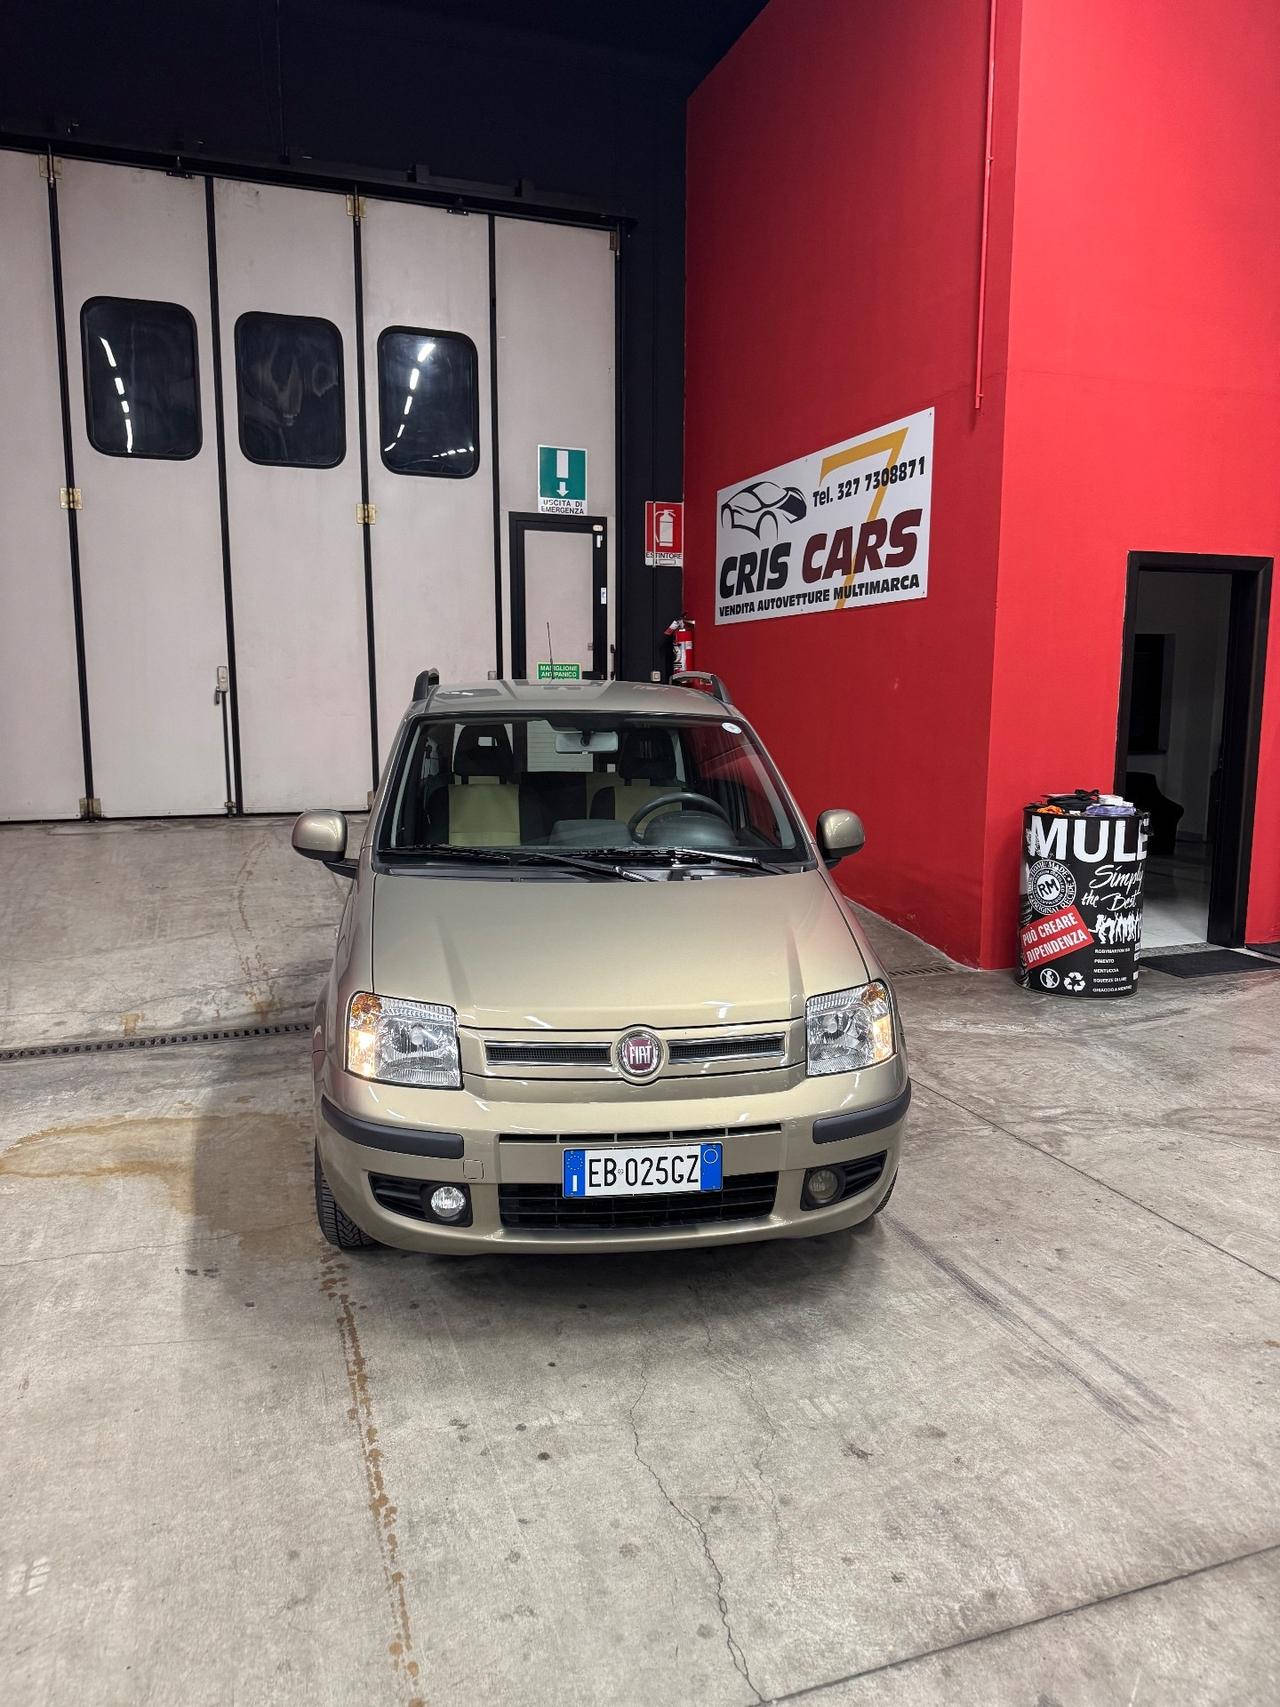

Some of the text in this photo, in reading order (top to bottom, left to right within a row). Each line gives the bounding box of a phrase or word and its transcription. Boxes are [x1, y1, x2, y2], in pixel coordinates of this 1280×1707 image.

[813, 456, 925, 507] Tel. 327 7308871
[541, 506, 584, 514] EMERGENZA
[543, 499, 571, 507] USCITA
[719, 508, 923, 599] CRIS CARS
[719, 574, 920, 617] VENDITA AUTOVETTURE MULTIMARCA
[1038, 878, 1060, 898] RM
[1081, 889, 1141, 911] the Best
[1022, 912, 1078, 946] PUÒ CREARE
[1026, 929, 1088, 963] DIPENDENZA
[629, 1045, 652, 1065] FIAT
